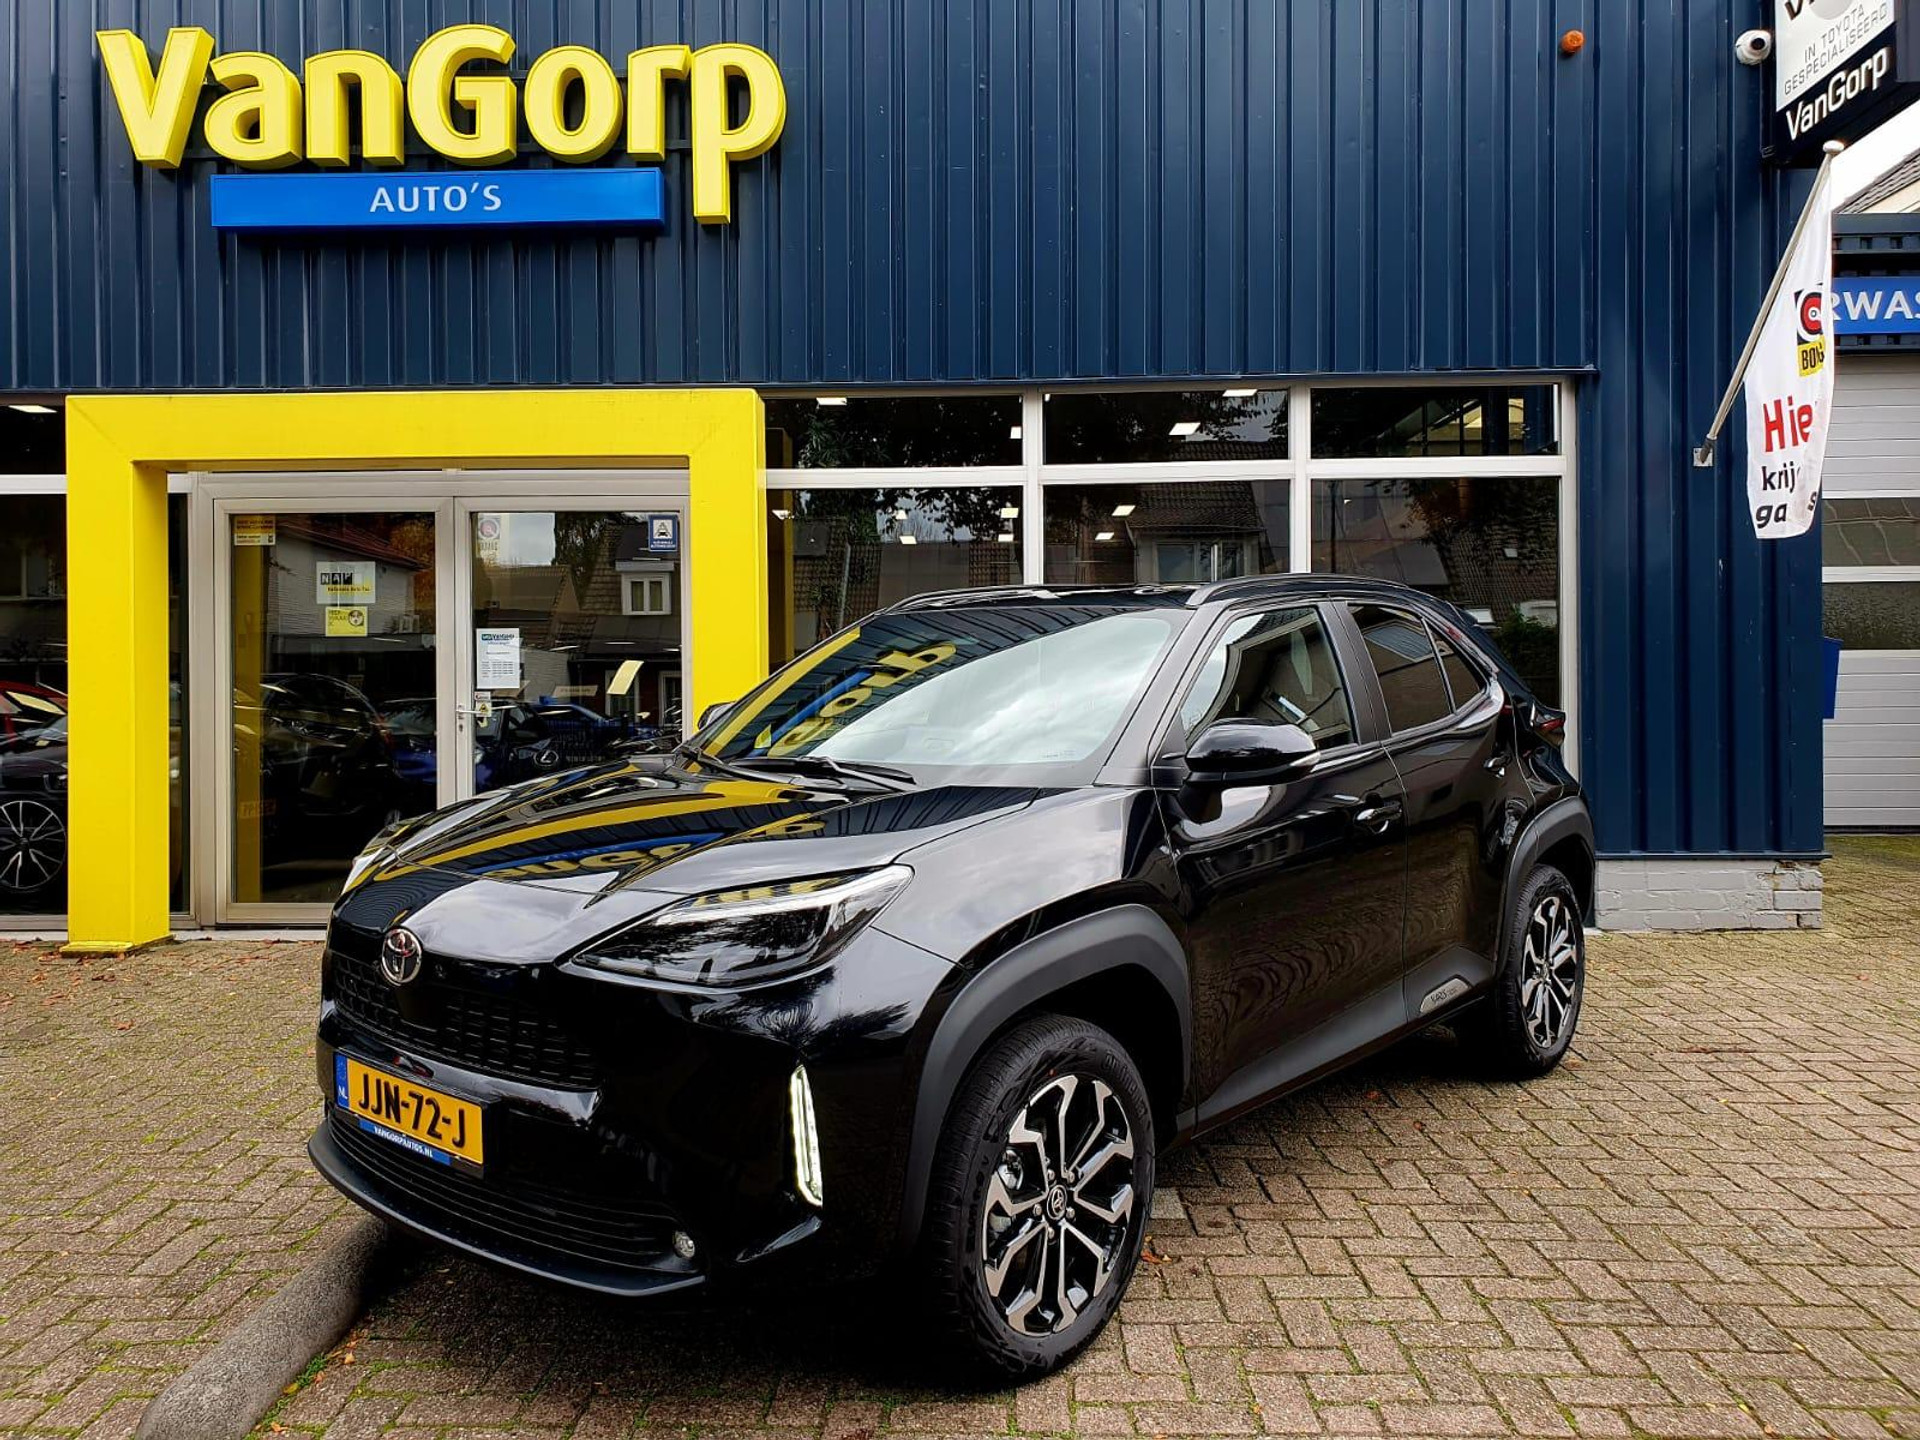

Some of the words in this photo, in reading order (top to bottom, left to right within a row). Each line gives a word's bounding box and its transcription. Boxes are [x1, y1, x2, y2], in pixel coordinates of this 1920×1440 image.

[1784, 3, 1888, 95] GESPECIALISEERD
[1804, 43, 1816, 63] IN
[1821, 4, 1865, 45] TOYOTA
[1785, 47, 1889, 141] VanGorp
[96, 23, 786, 225] VanGorp
[369, 183, 503, 213] AUTO'S
[1763, 395, 1817, 452] Hie
[1761, 460, 1800, 493] krij
[338, 1085, 348, 1100] NL
[358, 1073, 466, 1148] JJN-72-J
[374, 1125, 433, 1159] VANGORPAUTOS.NL
